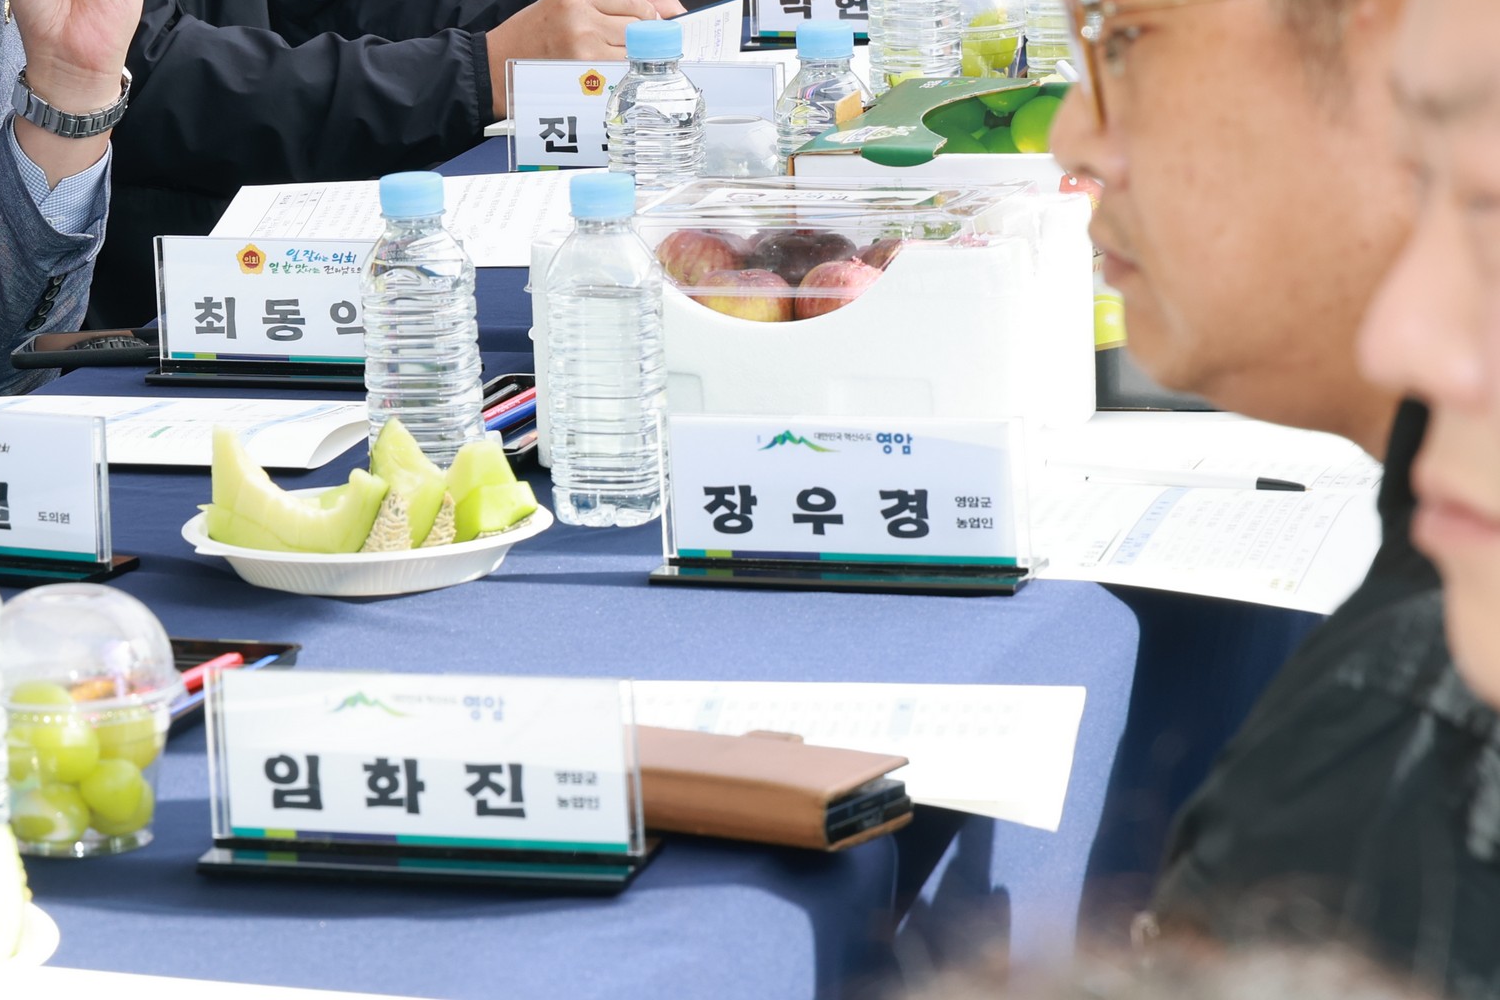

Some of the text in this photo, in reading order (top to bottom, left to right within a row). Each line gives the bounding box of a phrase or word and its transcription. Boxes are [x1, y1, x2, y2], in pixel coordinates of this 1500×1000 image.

[538, 116, 610, 154] 진
[243, 255, 260, 265] 의회
[331, 251, 357, 265] 의회
[875, 432, 913, 455] 영암
[37, 510, 71, 525] 도의원
